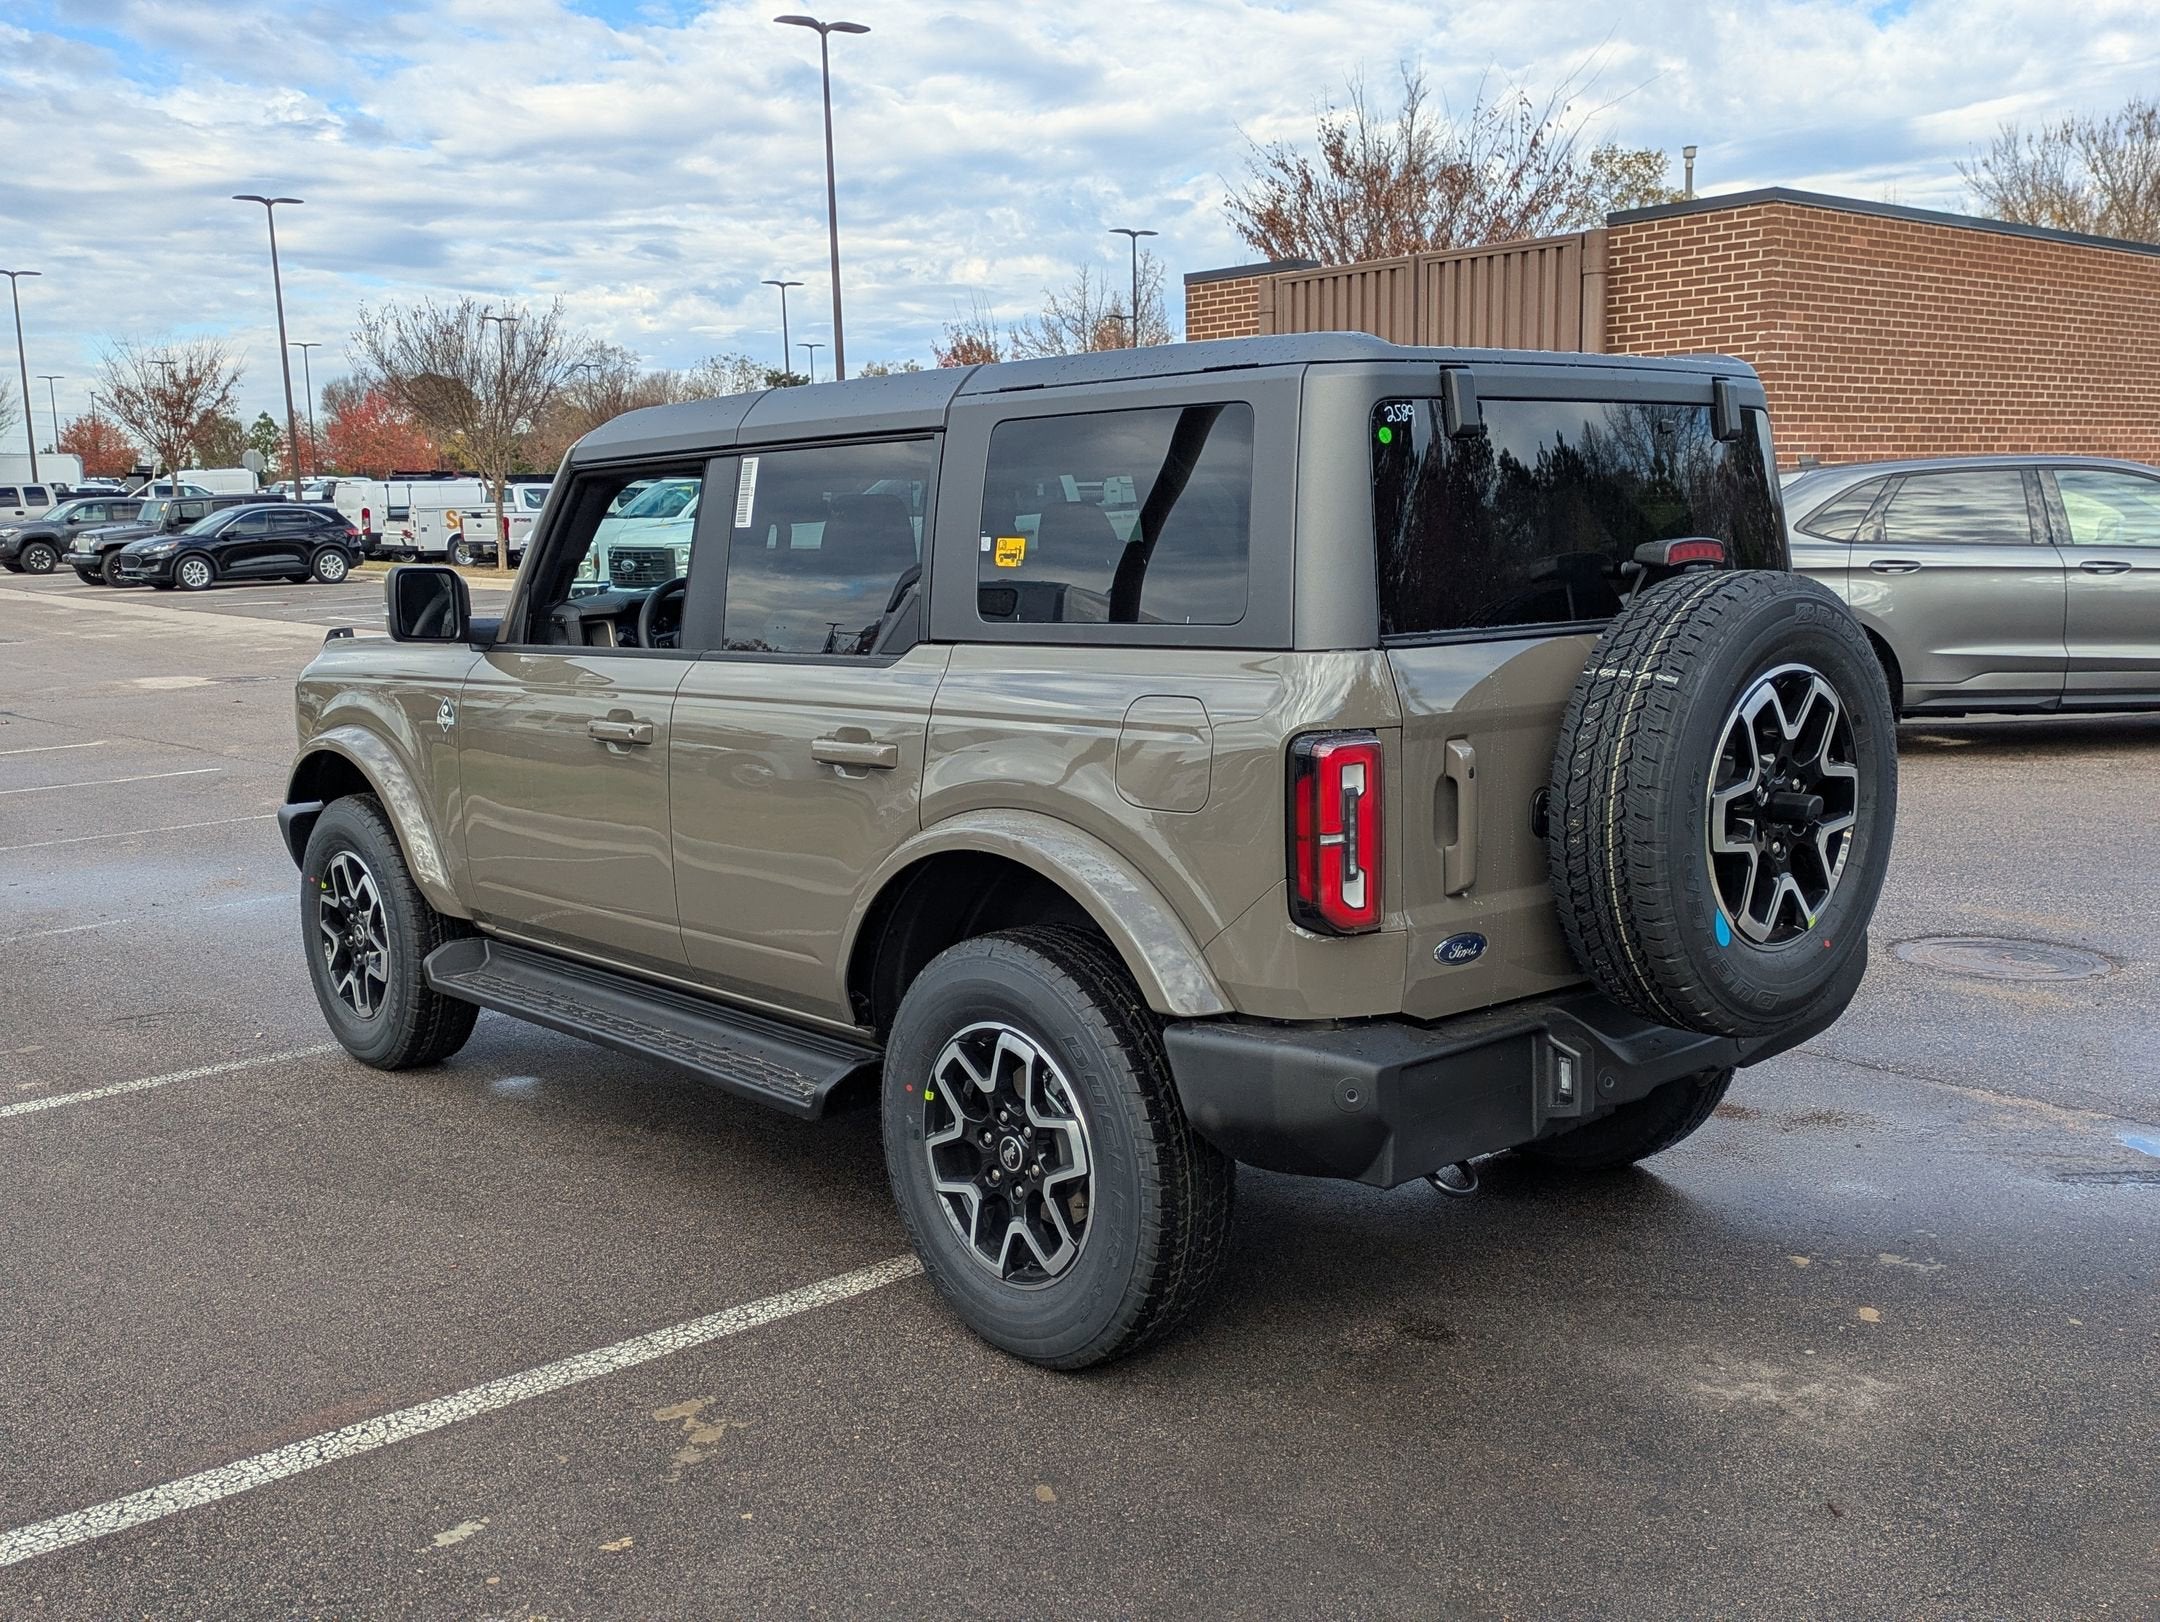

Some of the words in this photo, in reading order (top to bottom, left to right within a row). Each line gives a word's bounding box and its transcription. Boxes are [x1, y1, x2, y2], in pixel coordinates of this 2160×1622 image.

[1383, 403, 1417, 427] 2589
[446, 510, 459, 530] S
[1794, 601, 1897, 794] BRIDGESTONE
[1681, 848, 1781, 1011] DUELER
